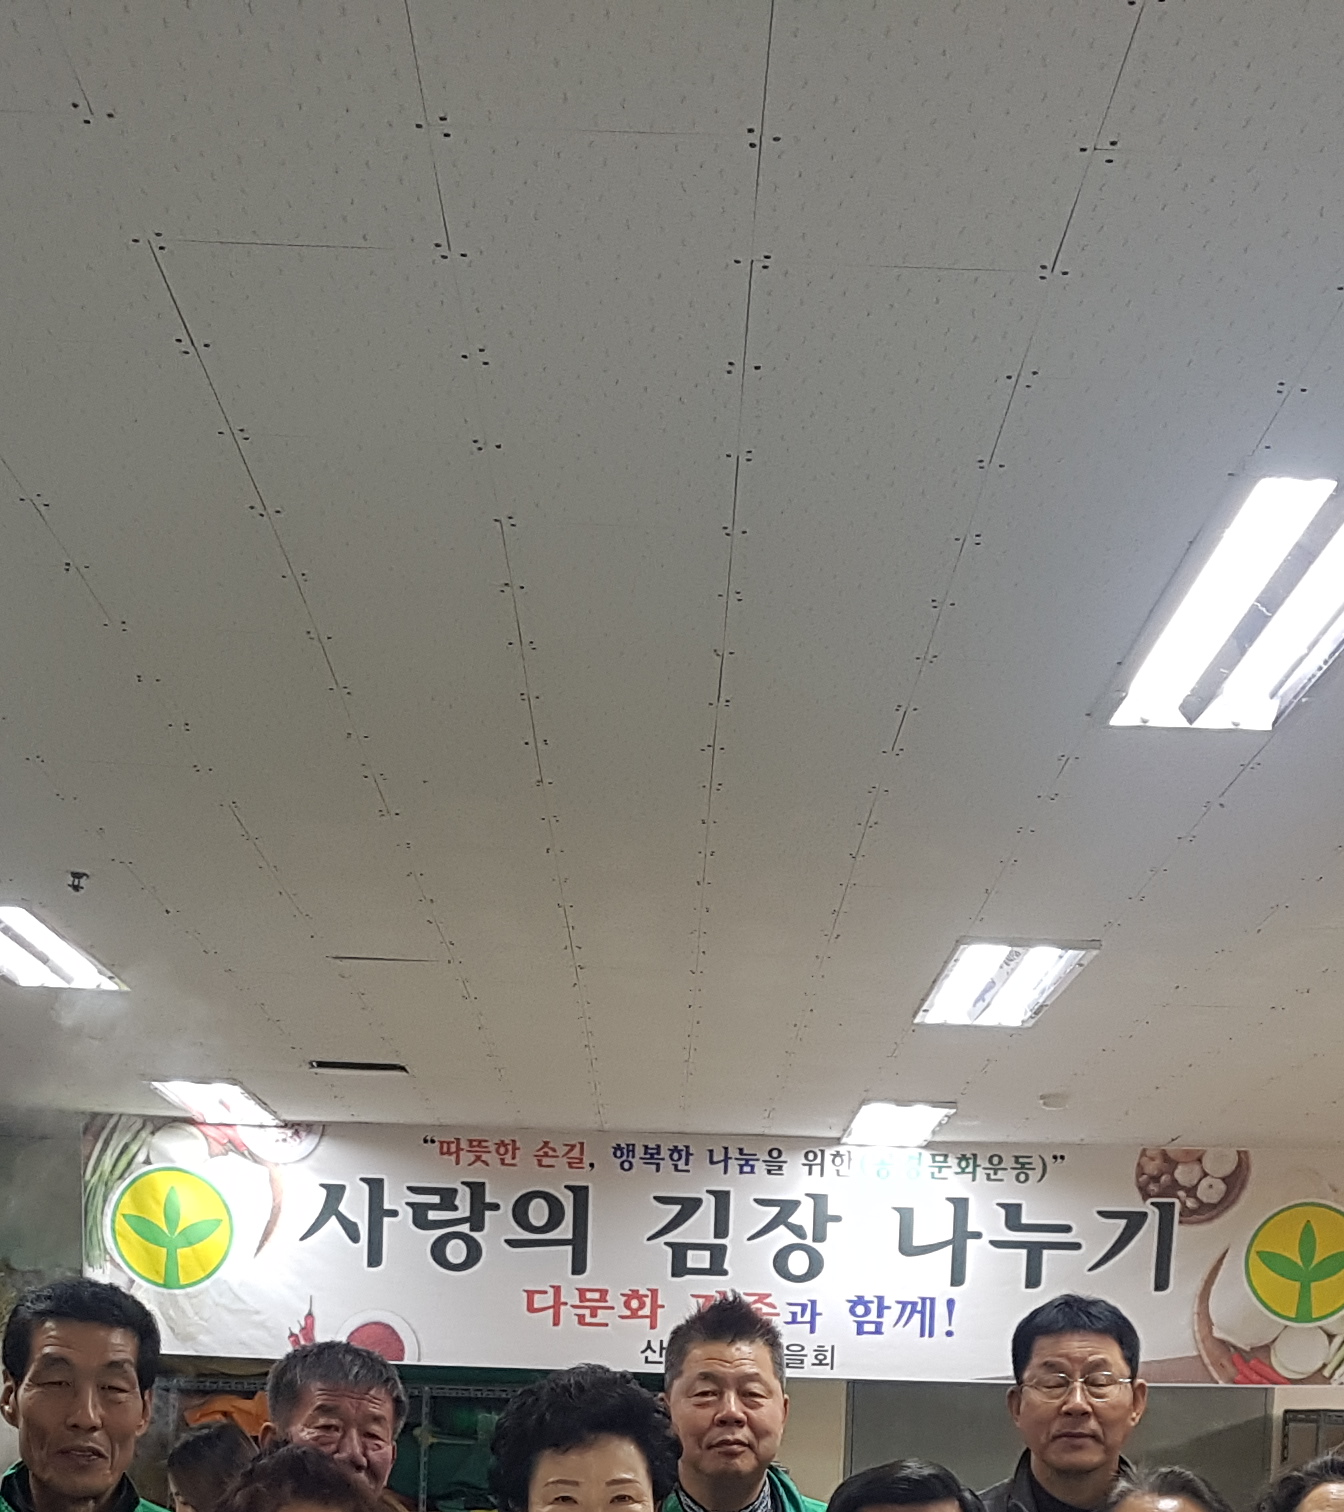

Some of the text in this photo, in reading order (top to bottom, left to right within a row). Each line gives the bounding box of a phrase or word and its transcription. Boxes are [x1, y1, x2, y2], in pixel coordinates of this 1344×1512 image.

[533, 1140, 595, 1172] 손길,
[612, 1143, 693, 1173] 행복한
[707, 1145, 788, 1176] 나눔을
[801, 1149, 853, 1178] 위한
[298, 1177, 1180, 1292] 사랑의 김장 나누기
[523, 1285, 664, 1330] 다문화
[846, 1295, 957, 1338] 함께!
